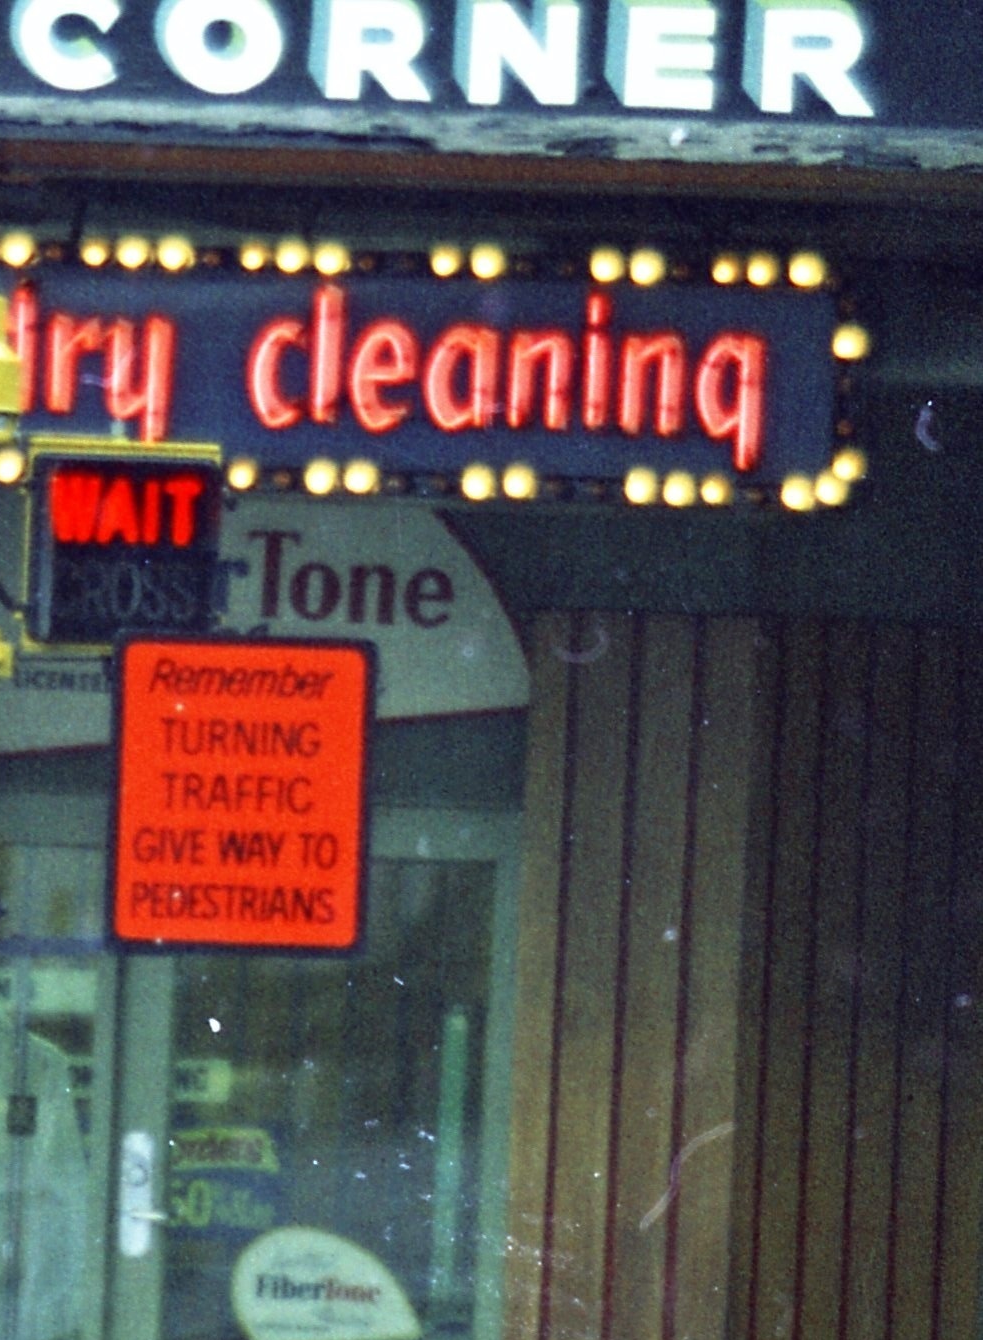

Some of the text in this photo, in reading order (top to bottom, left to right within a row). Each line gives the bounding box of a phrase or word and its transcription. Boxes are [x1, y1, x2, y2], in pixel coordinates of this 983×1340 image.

[11, 0, 875, 117] CORNER
[246, 280, 766, 471] cleaning
[48, 469, 204, 547] WAIT
[148, 657, 334, 700] Remember
[161, 717, 321, 758] TURNING
[161, 772, 313, 814] TRAFFIC
[132, 826, 339, 870] GIVE WAY TO
[131, 881, 335, 925] PEDESTRIANS
